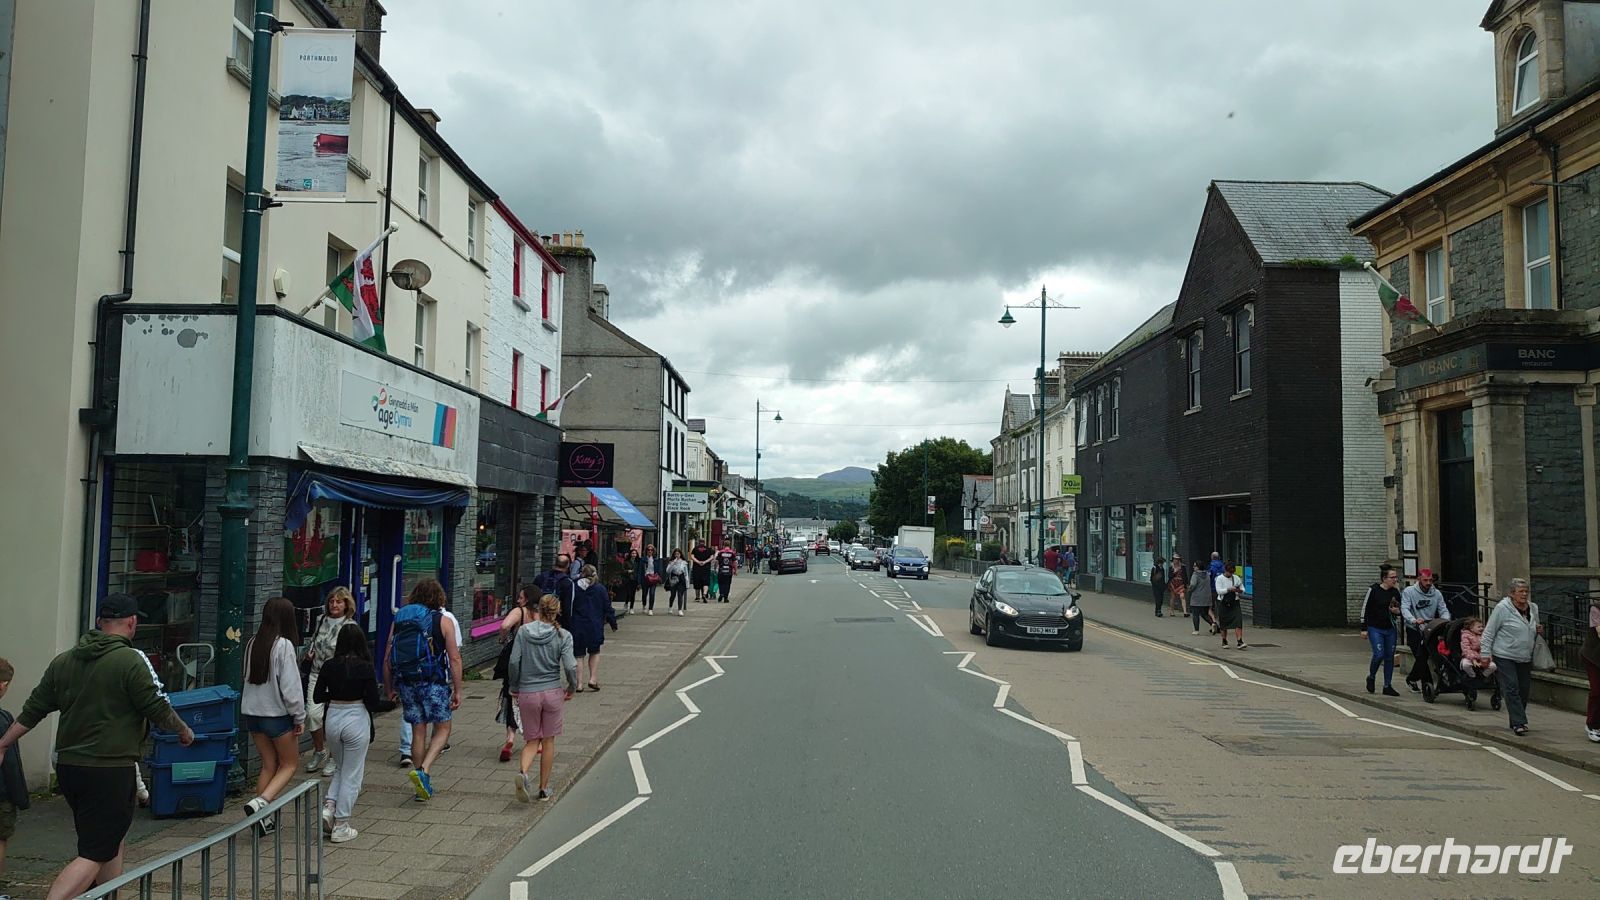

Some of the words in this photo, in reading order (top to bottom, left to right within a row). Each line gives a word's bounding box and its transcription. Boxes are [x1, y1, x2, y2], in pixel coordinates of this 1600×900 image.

[1518, 349, 1555, 358] BANC
[1428, 356, 1458, 374] BANC
[378, 408, 394, 430] age
[394, 410, 412, 428] Cymru
[572, 454, 604, 468] Kitty's
